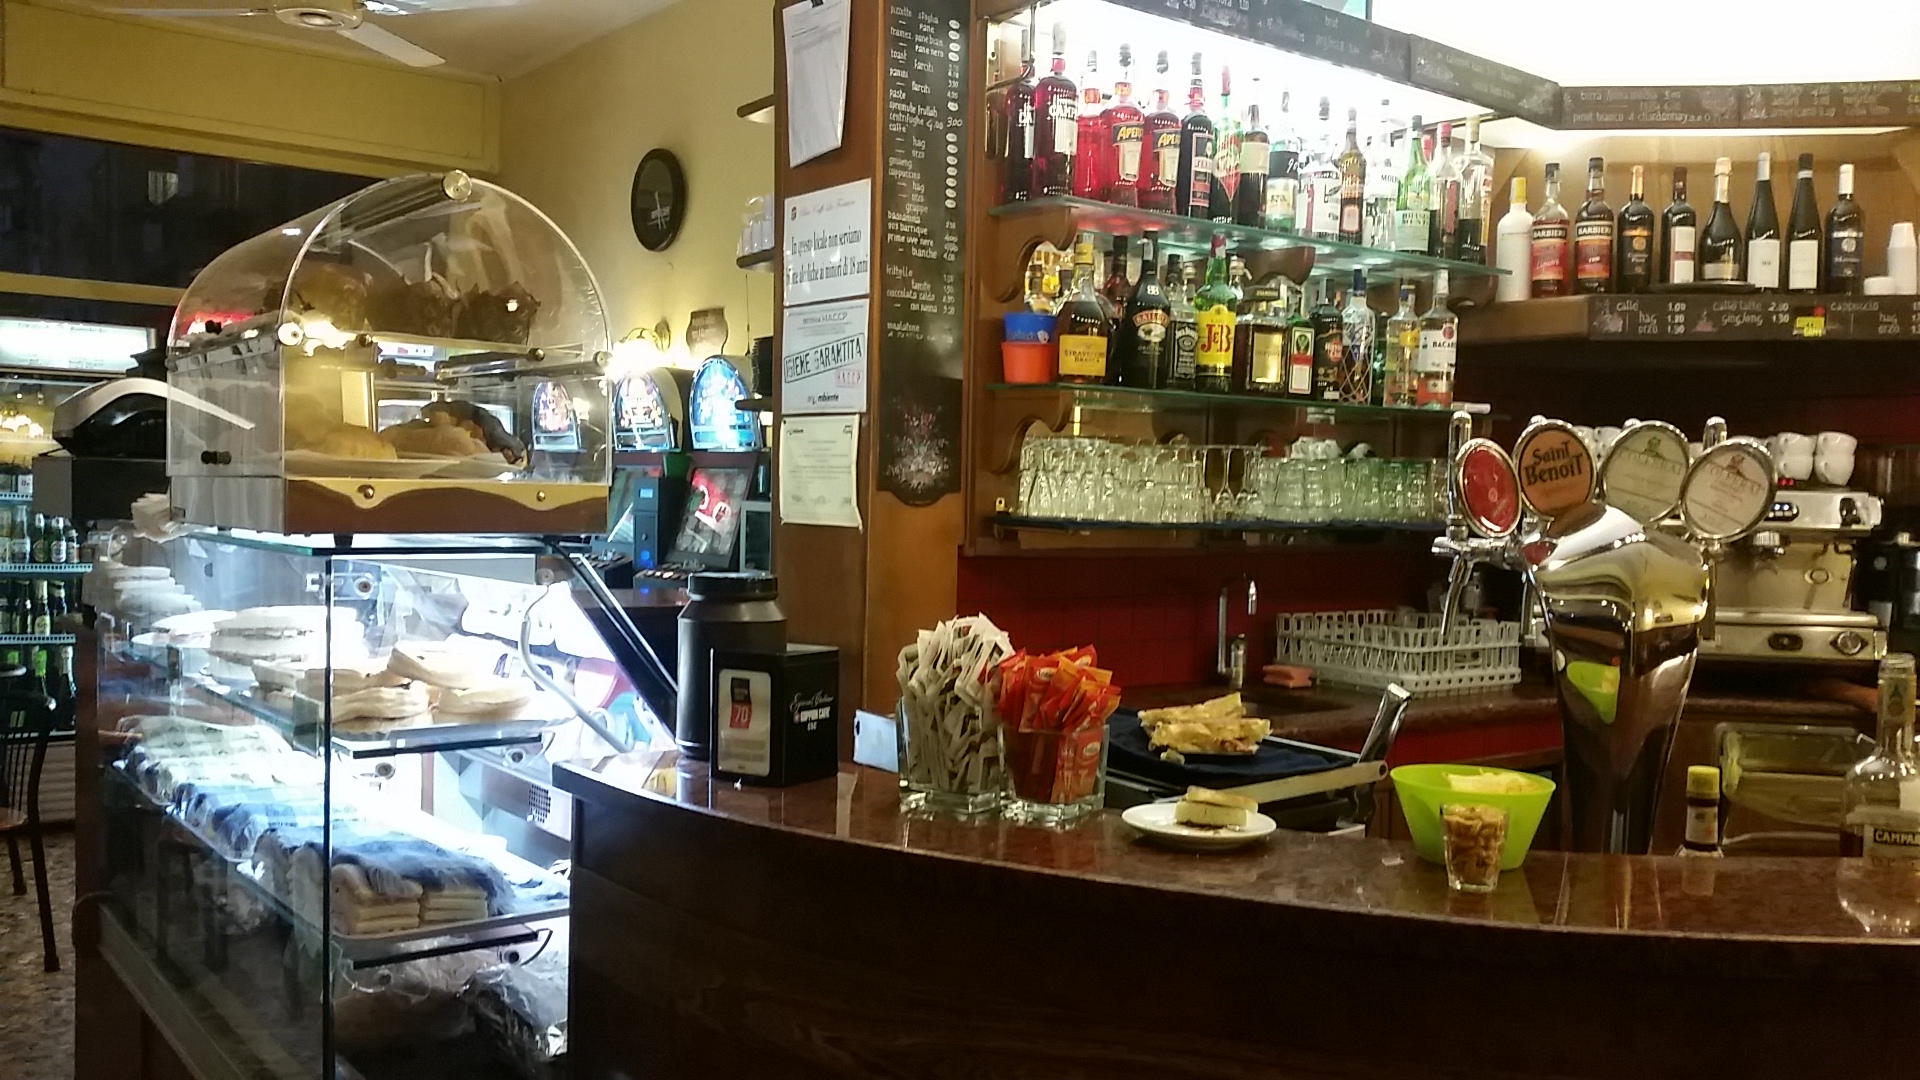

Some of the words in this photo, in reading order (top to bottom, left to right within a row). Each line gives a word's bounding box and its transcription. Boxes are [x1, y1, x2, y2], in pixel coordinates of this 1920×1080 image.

[920, 23, 935, 34] pane
[914, 44, 930, 54] pane
[930, 49, 944, 58] nero
[890, 89, 906, 100] paste
[912, 136, 926, 150] hag
[912, 150, 925, 158] orzo
[888, 168, 921, 180] cappuccino
[912, 181, 925, 194] hag
[912, 193, 924, 202] orzo
[900, 222, 928, 236] barrique
[1578, 224, 1612, 235] BARBIERI
[886, 288, 918, 300] cioccolata
[919, 292, 936, 302] calda
[1668, 302, 1686, 312] 1.00
[1639, 311, 1658, 325] hag
[1667, 314, 1685, 323] 1.20
[1638, 324, 1658, 334] orzo
[814, 337, 862, 370] GARANTITA
[736, 706, 748, 723] 70
